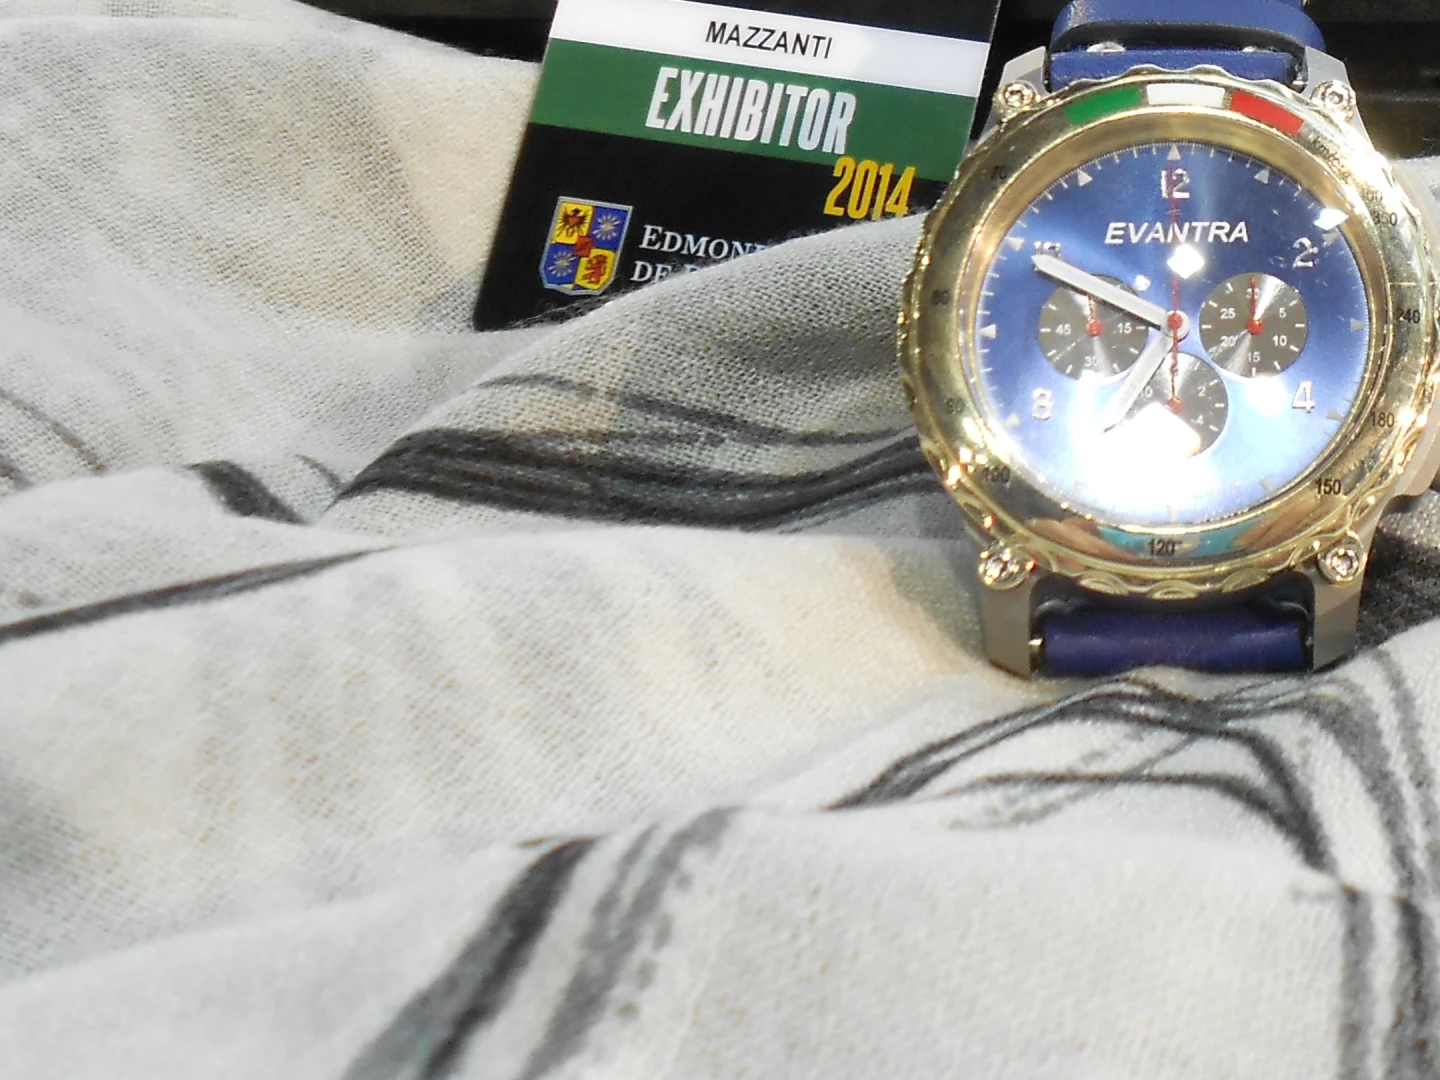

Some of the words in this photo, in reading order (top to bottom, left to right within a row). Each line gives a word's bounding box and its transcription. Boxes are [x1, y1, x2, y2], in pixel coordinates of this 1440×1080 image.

[705, 20, 833, 59] MAZZANTI
[645, 66, 856, 155] EXHIBITOR
[823, 156, 916, 220] 2014
[1161, 168, 1191, 199] 12
[1105, 221, 1249, 245] EVANTRA
[639, 224, 766, 260] EDMON
[1292, 237, 1319, 269] 2
[1220, 307, 1236, 319] 25
[1278, 307, 1287, 319] 5
[1396, 308, 1421, 325] 240
[1055, 323, 1071, 335] 45
[1117, 322, 1132, 334] 15
[1220, 335, 1236, 347] 20
[1273, 335, 1288, 347] 10
[1084, 355, 1100, 368] 30
[1248, 351, 1261, 363] 15
[1198, 385, 1207, 397] 2
[1292, 381, 1316, 414] 4
[1032, 387, 1053, 421] 8
[1370, 412, 1396, 428] 180
[1314, 478, 1342, 495] 150
[1148, 538, 1176, 556] 120
